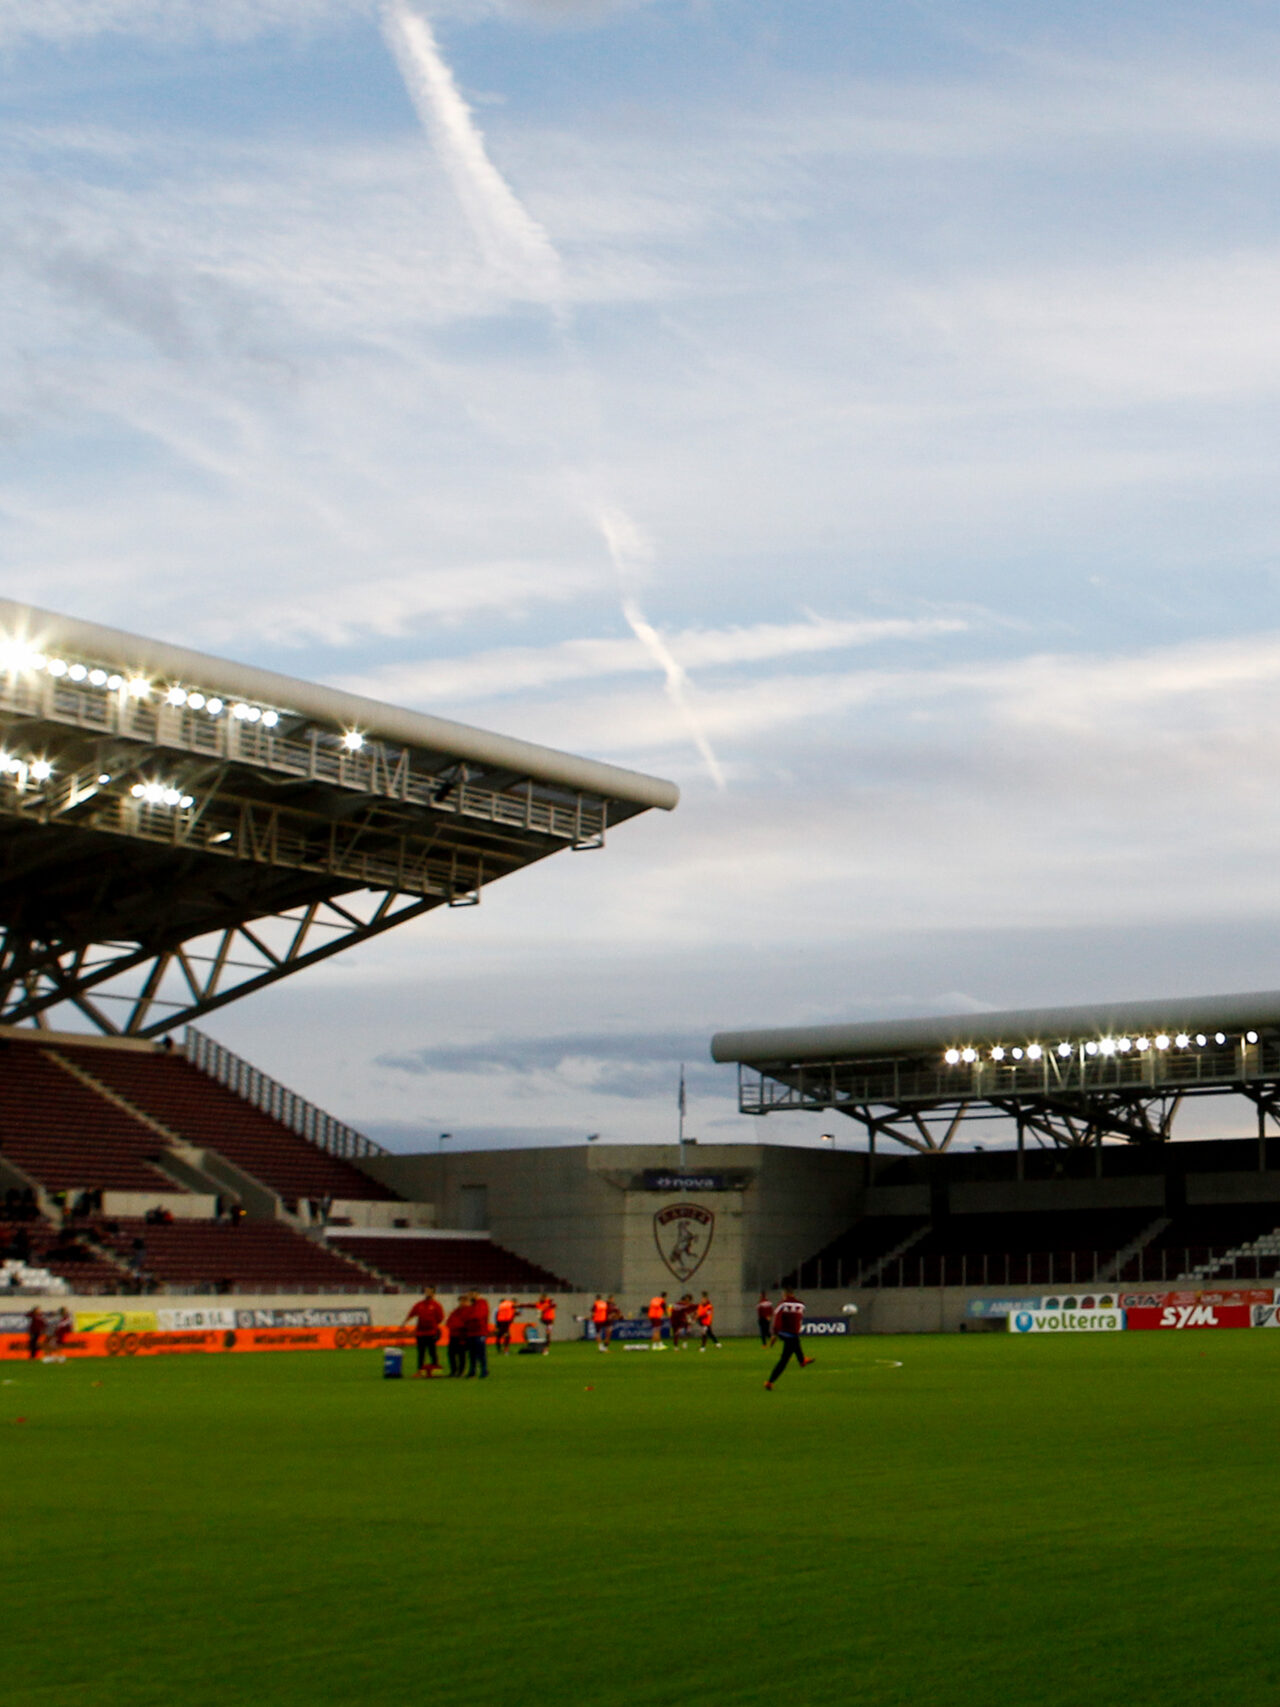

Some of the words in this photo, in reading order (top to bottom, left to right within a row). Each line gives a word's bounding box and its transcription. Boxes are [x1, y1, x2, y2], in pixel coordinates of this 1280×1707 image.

[1035, 1312, 1117, 1329] volterra
[1160, 1306, 1219, 1329] SYM
[806, 1321, 846, 1334] nova
